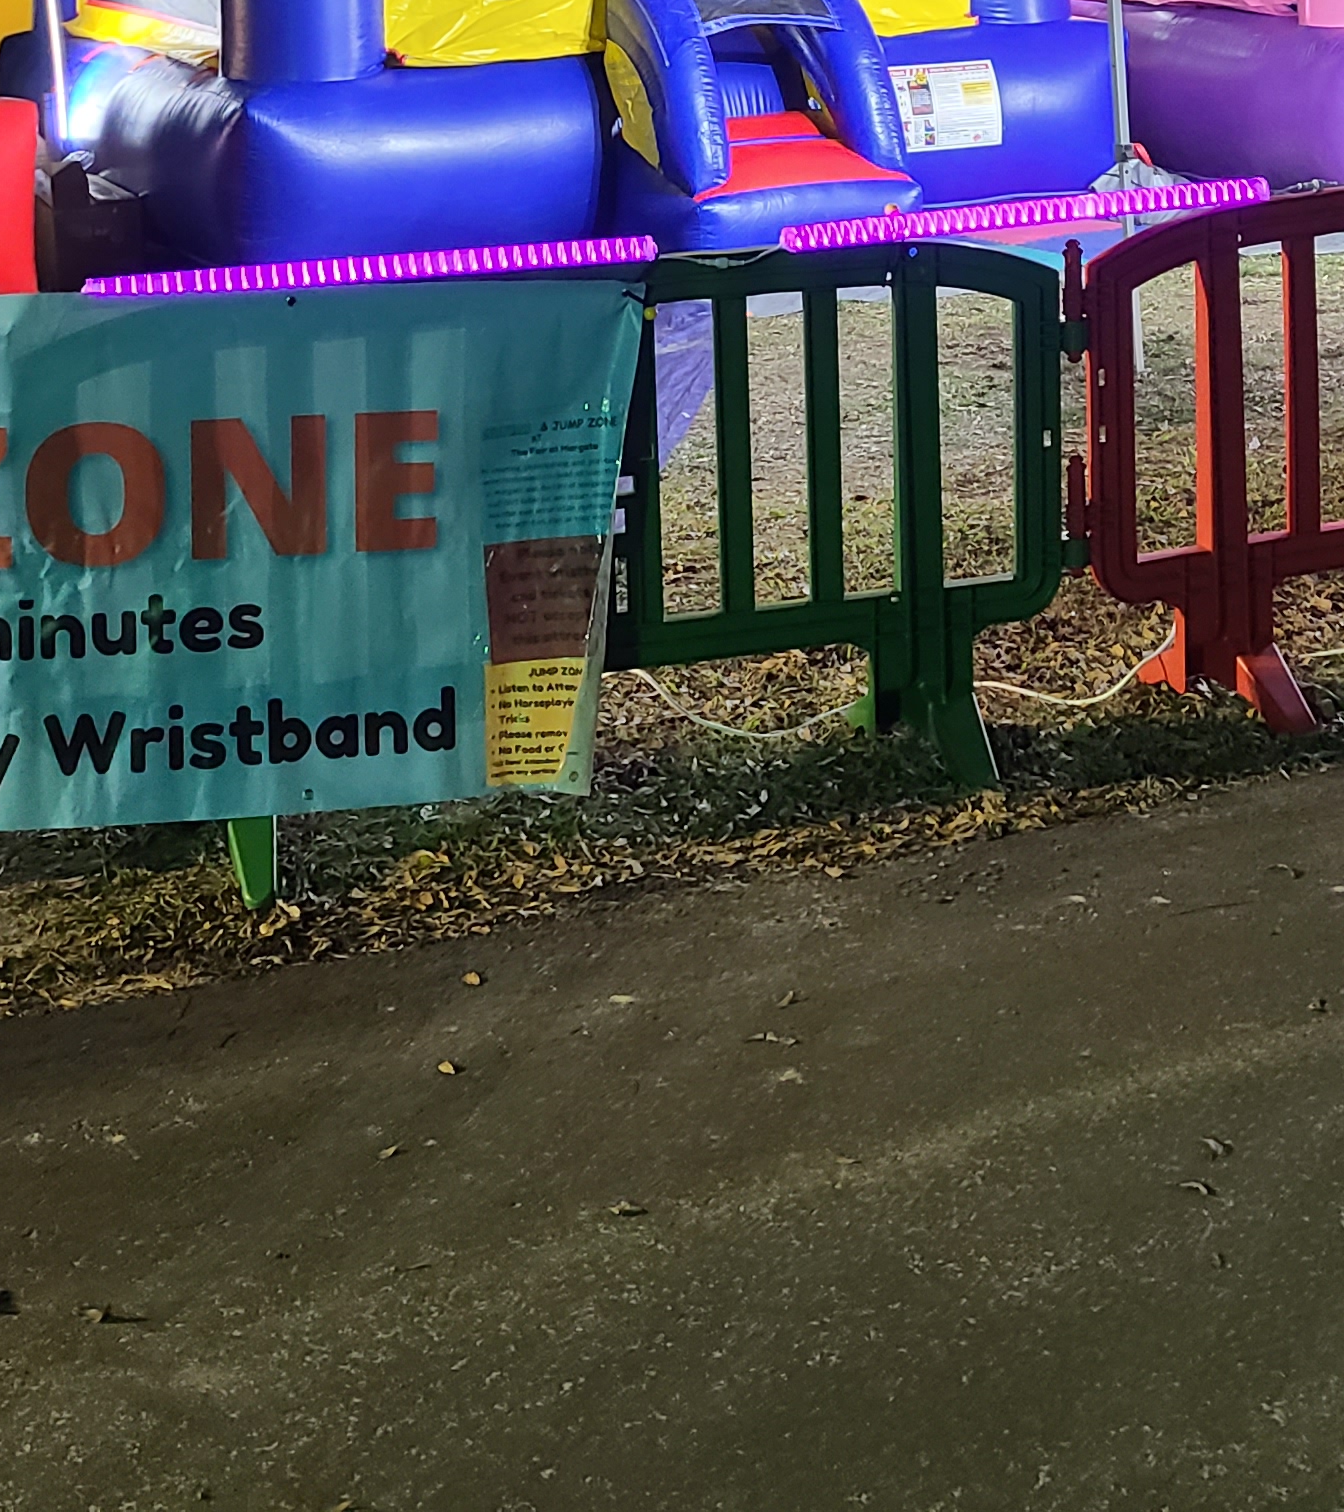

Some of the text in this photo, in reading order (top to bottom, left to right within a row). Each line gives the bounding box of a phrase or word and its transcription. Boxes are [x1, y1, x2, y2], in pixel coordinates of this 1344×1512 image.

[529, 667, 559, 678] JUMP
[498, 684, 529, 695] Listen
[532, 683, 544, 692] to
[498, 700, 512, 710] No
[43, 685, 456, 776] Wristband
[499, 730, 532, 741] Please
[499, 746, 512, 755] No
[515, 744, 542, 754] Food
